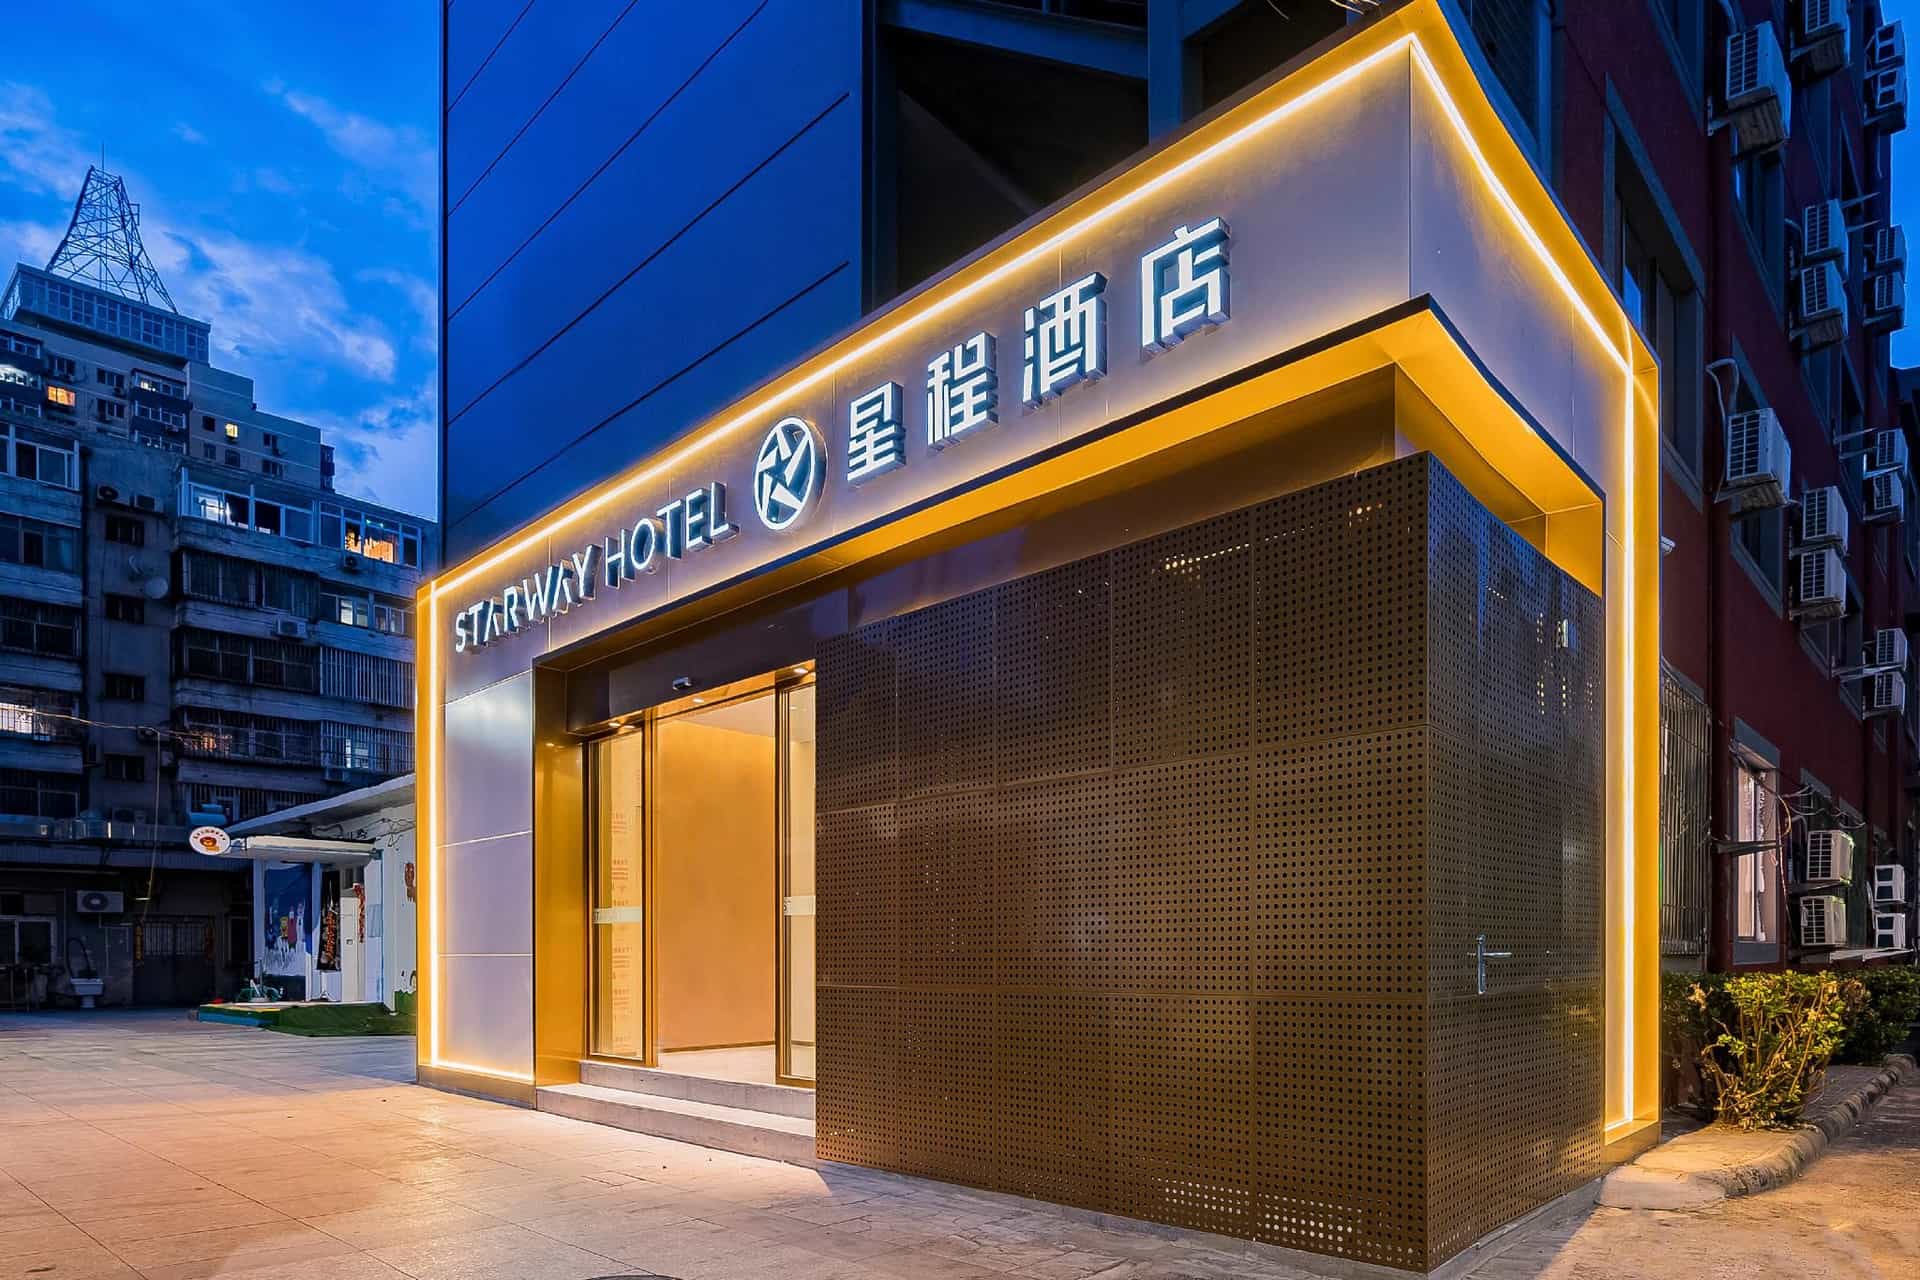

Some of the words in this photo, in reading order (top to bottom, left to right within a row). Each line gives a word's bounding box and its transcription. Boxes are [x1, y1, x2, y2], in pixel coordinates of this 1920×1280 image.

[847, 216, 1231, 485] 星程酒店
[455, 545, 600, 654] STARWAY
[605, 481, 736, 589] HOTEL
